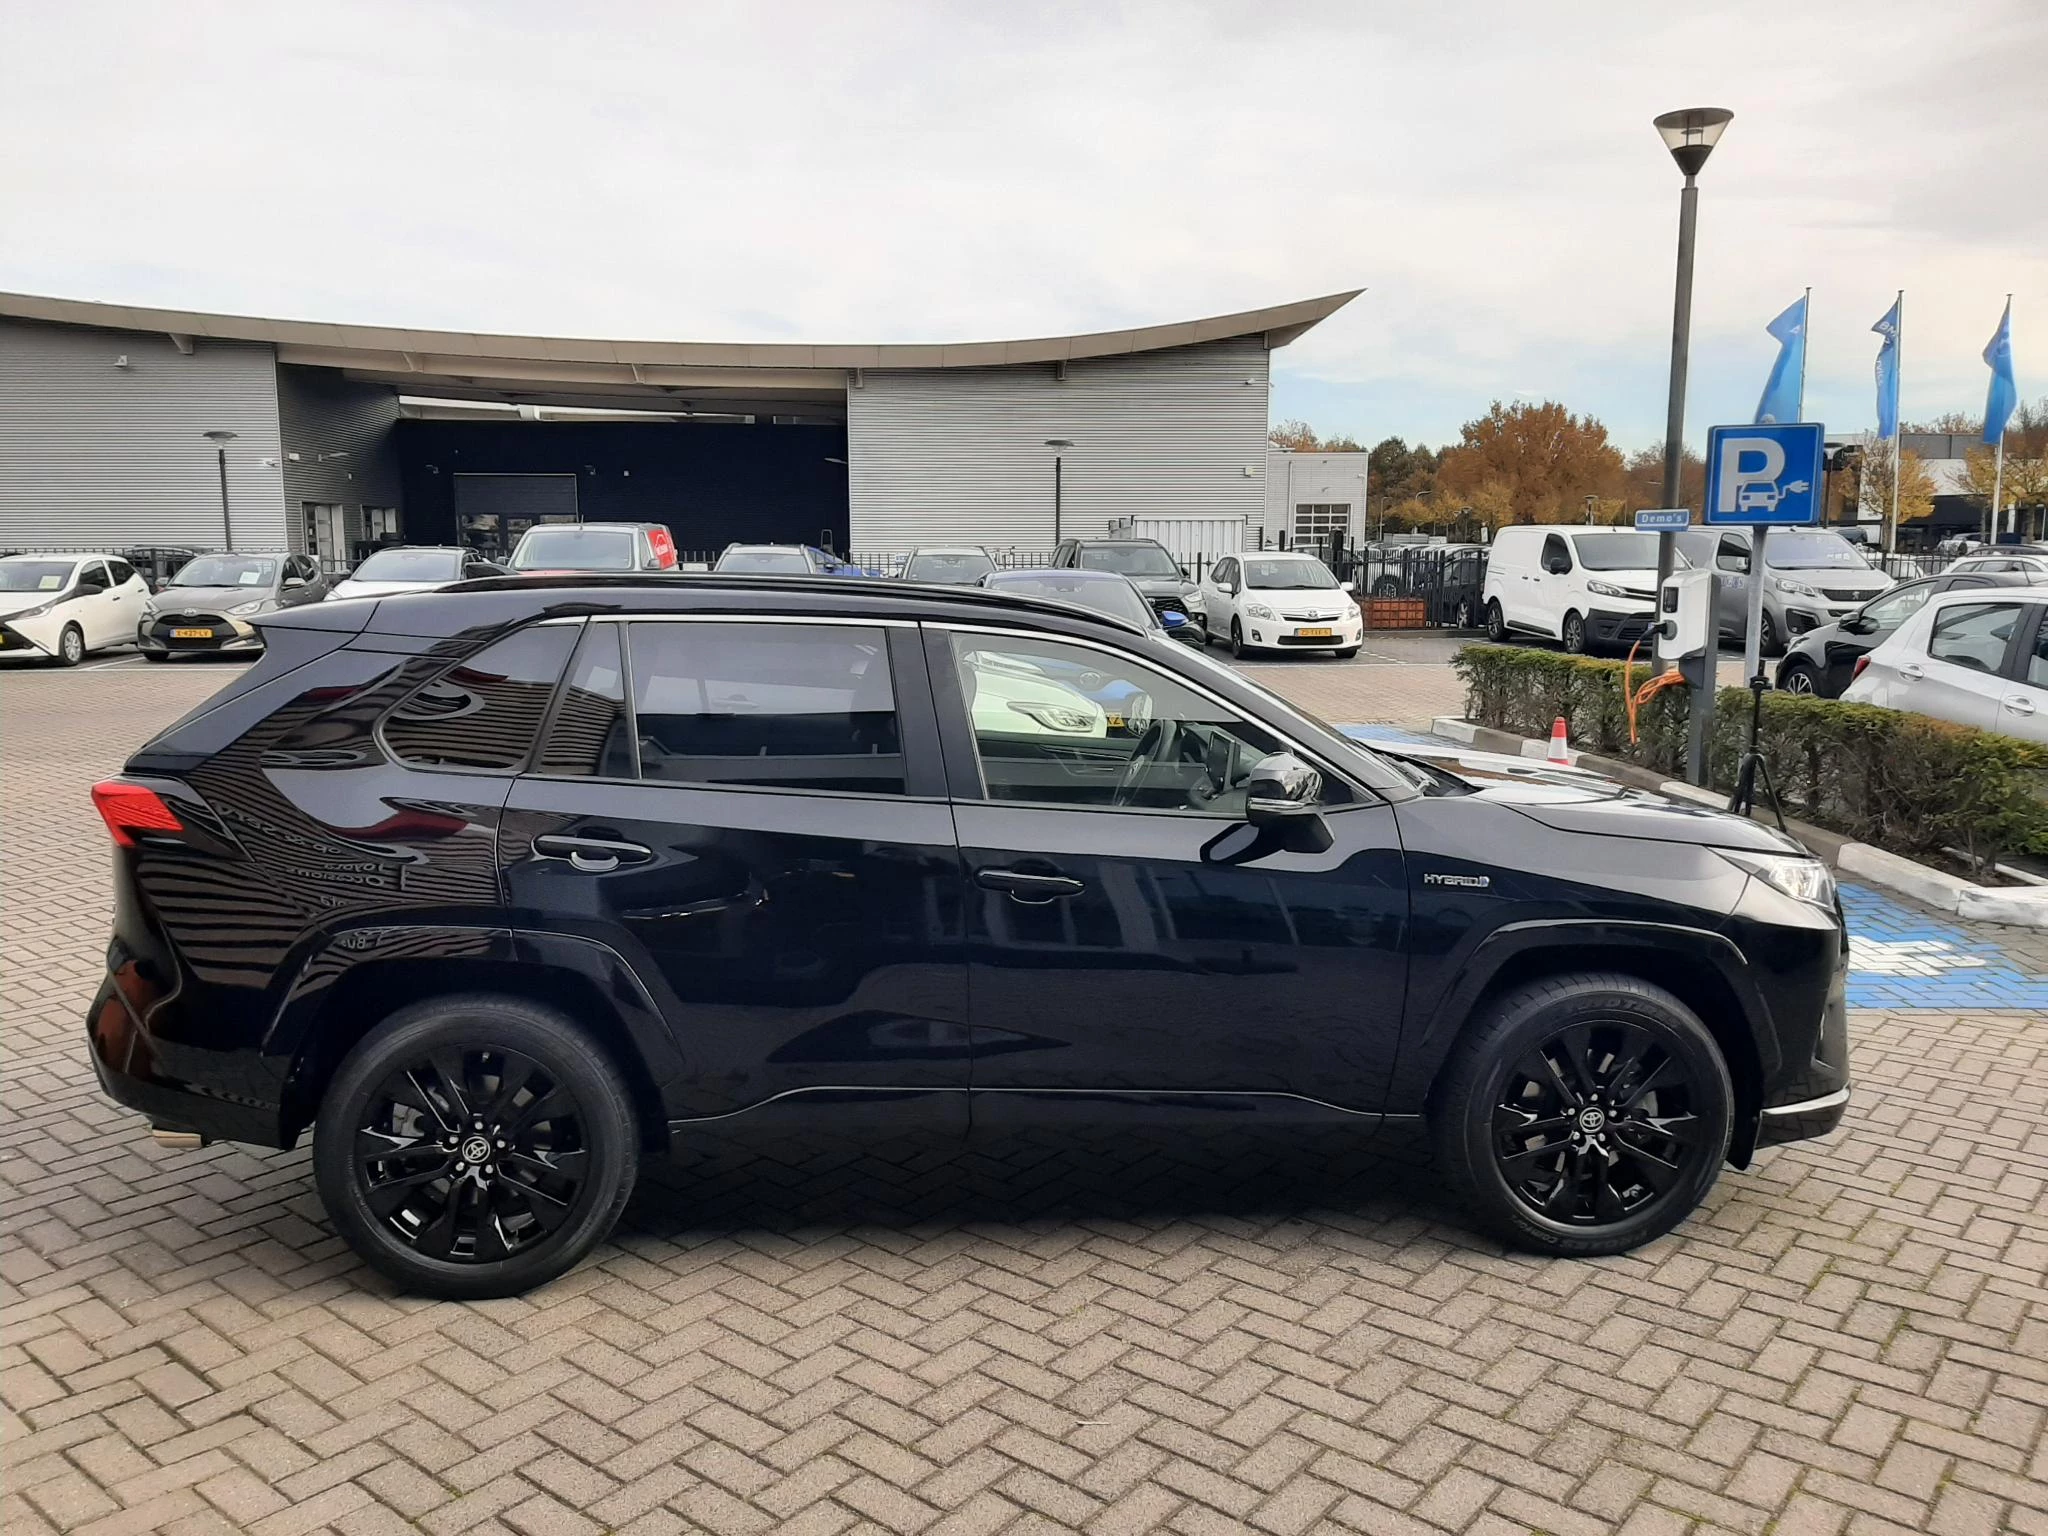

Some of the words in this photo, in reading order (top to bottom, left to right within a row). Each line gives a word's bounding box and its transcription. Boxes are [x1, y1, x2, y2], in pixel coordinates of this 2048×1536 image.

[1718, 437, 1786, 514] P
[1641, 513, 1683, 523] Demo's
[1423, 873, 1479, 887] HYBRID
